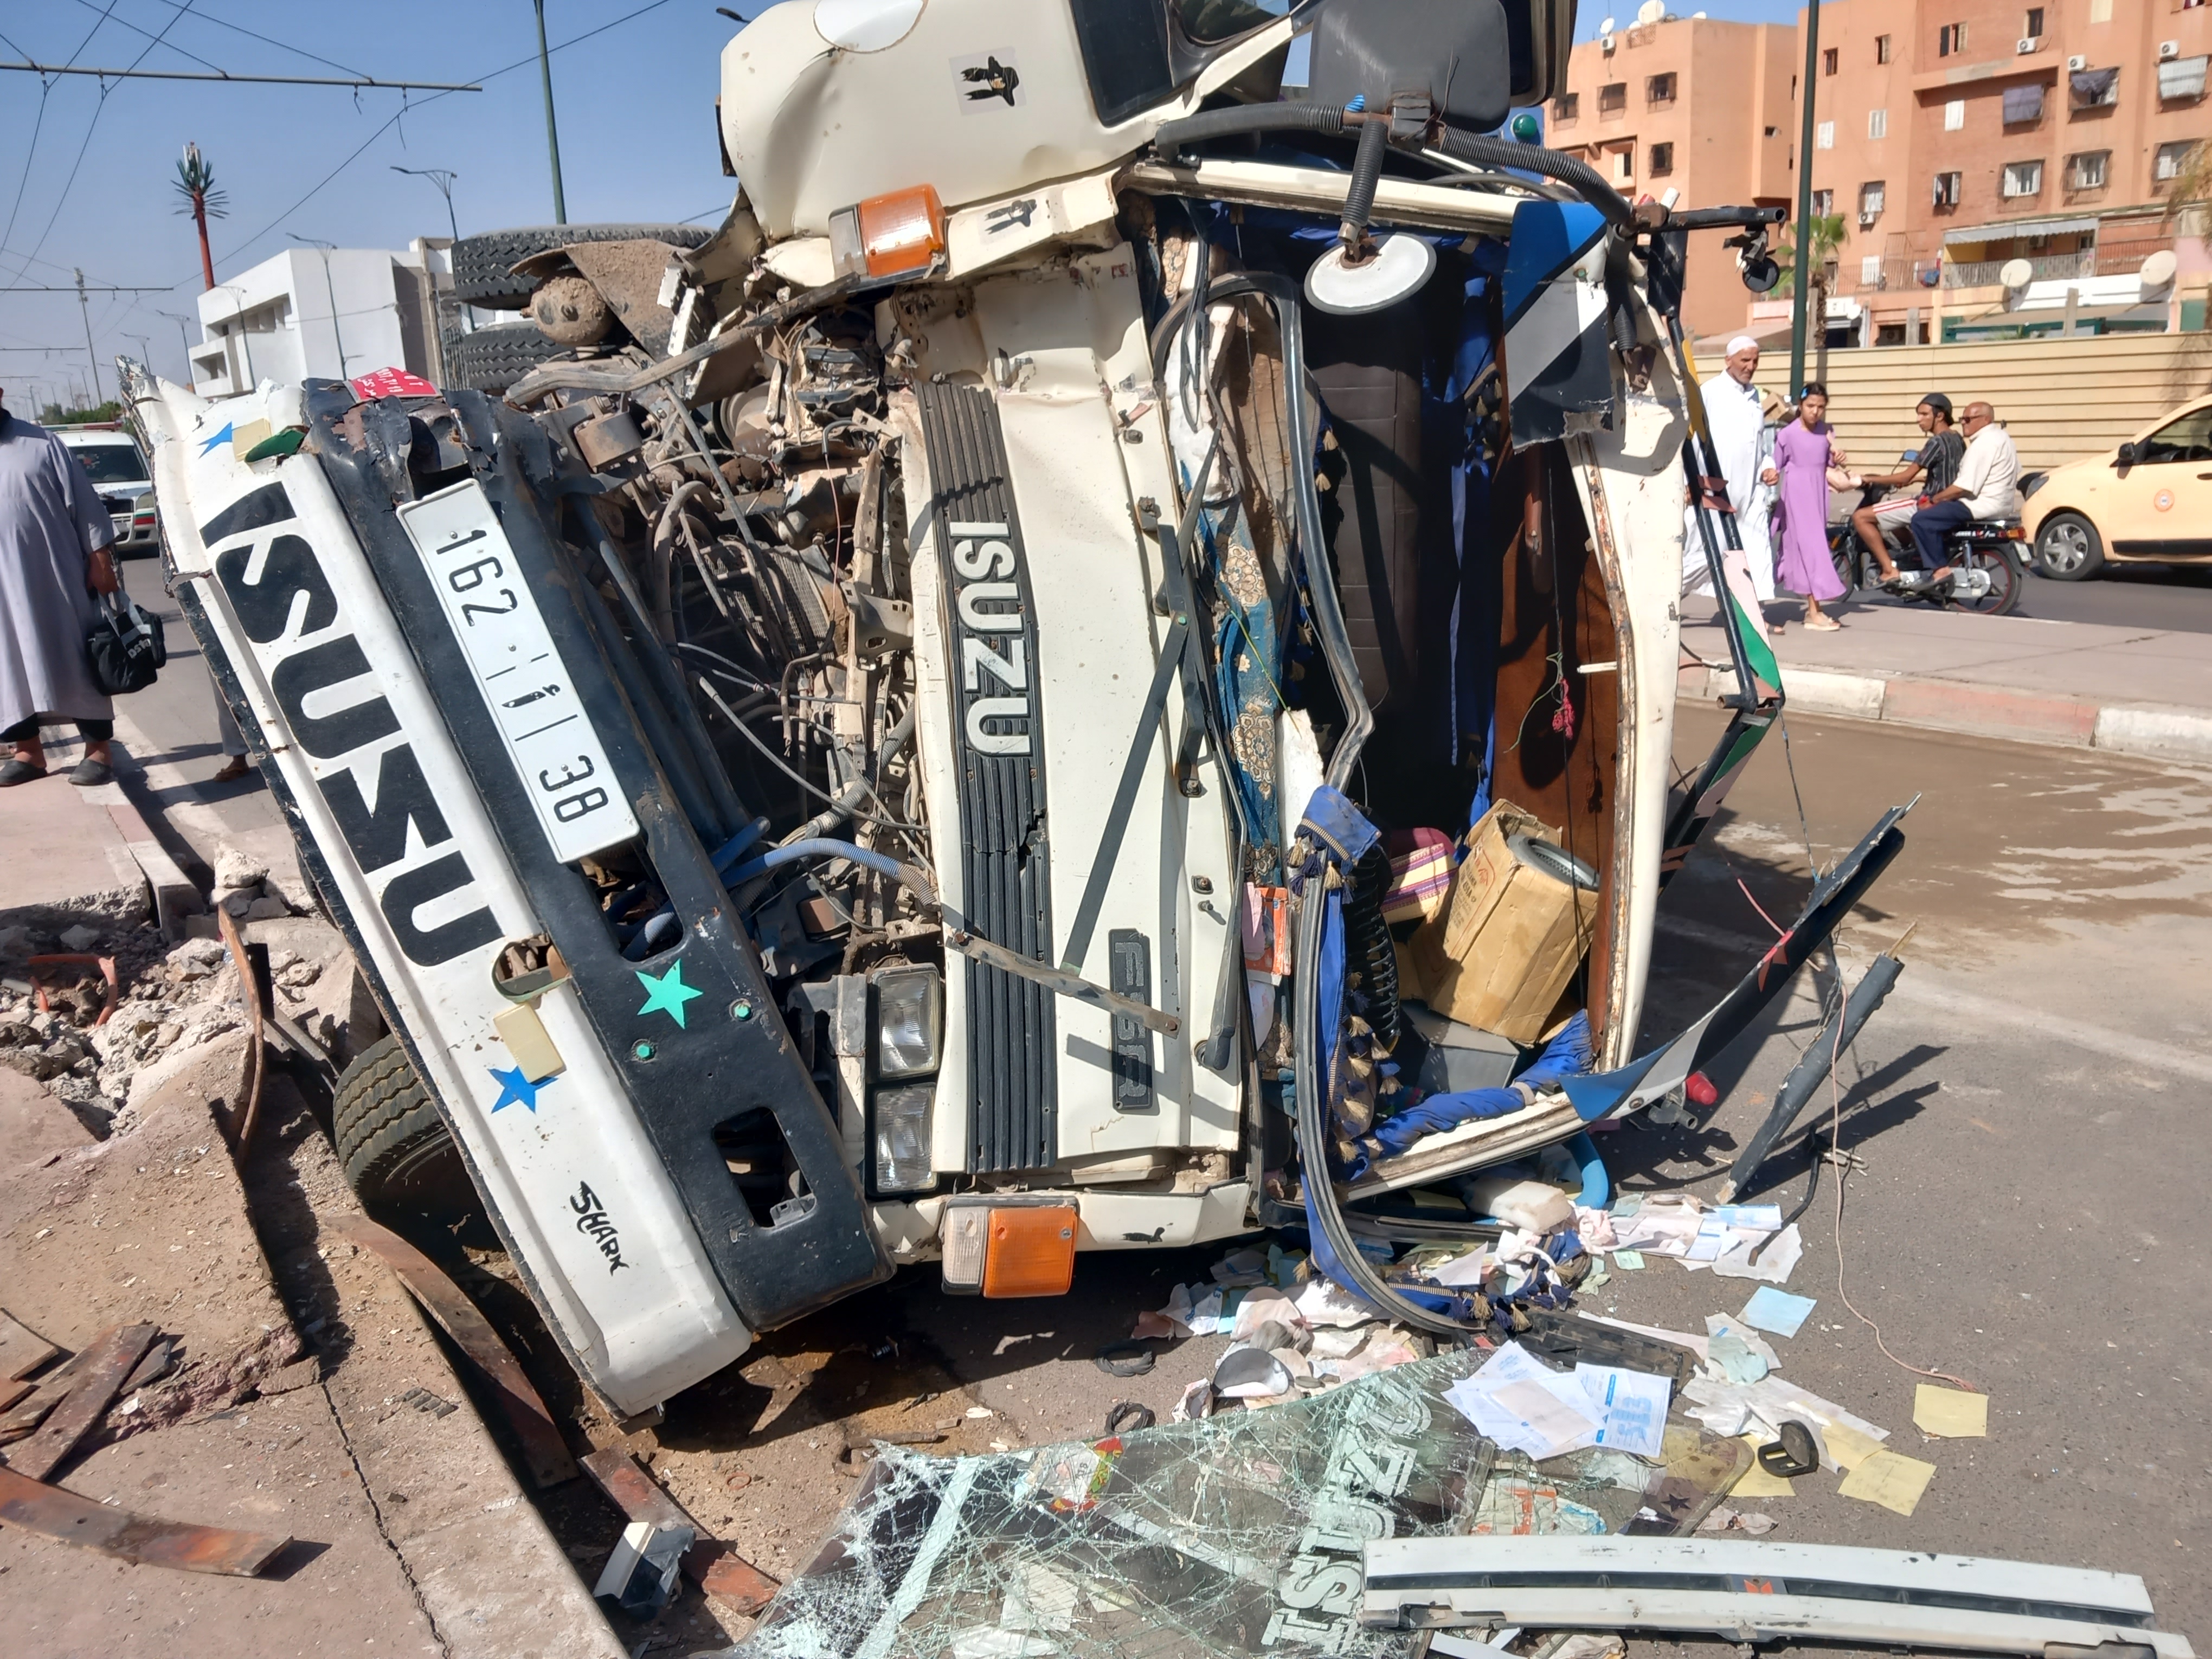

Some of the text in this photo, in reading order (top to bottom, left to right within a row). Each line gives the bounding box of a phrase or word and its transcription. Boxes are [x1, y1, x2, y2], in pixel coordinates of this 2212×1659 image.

[200, 481, 506, 967] ISUZU
[436, 529, 519, 627] 162
[538, 754, 610, 824] 38
[949, 521, 1034, 757] ISUZU
[569, 1180, 631, 1277] SHARK
